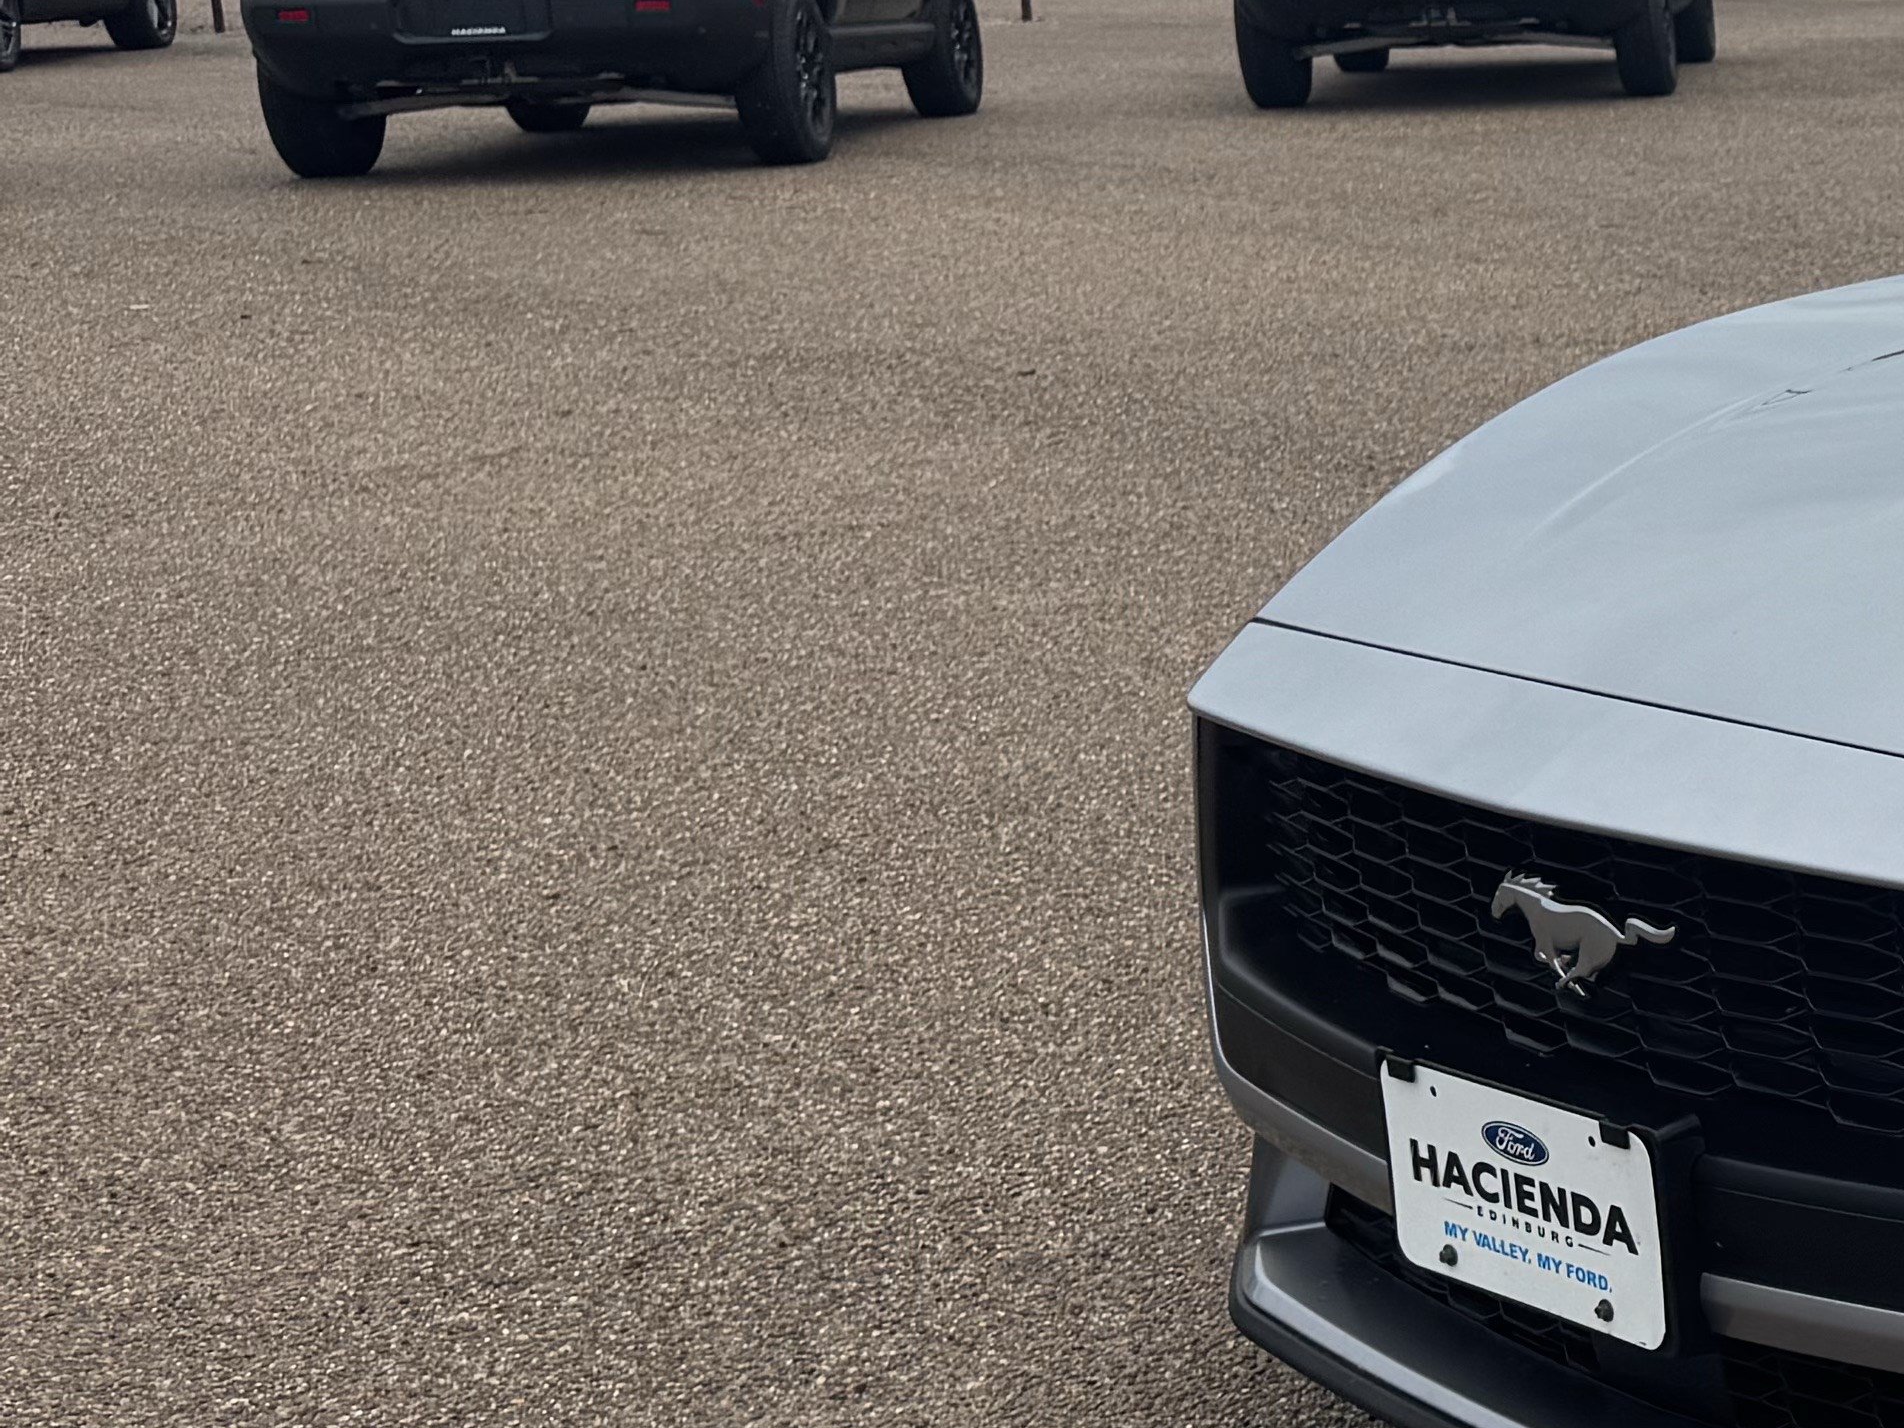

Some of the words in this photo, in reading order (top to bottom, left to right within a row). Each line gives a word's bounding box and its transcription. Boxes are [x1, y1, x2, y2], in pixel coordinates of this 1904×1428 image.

[1495, 1125, 1536, 1161] Ford
[1409, 1137, 1640, 1257] HACIENDA
[1444, 1221, 1469, 1242] MY
[1536, 1252, 1563, 1274] MY
[1476, 1205, 1575, 1249] EDINBURG
